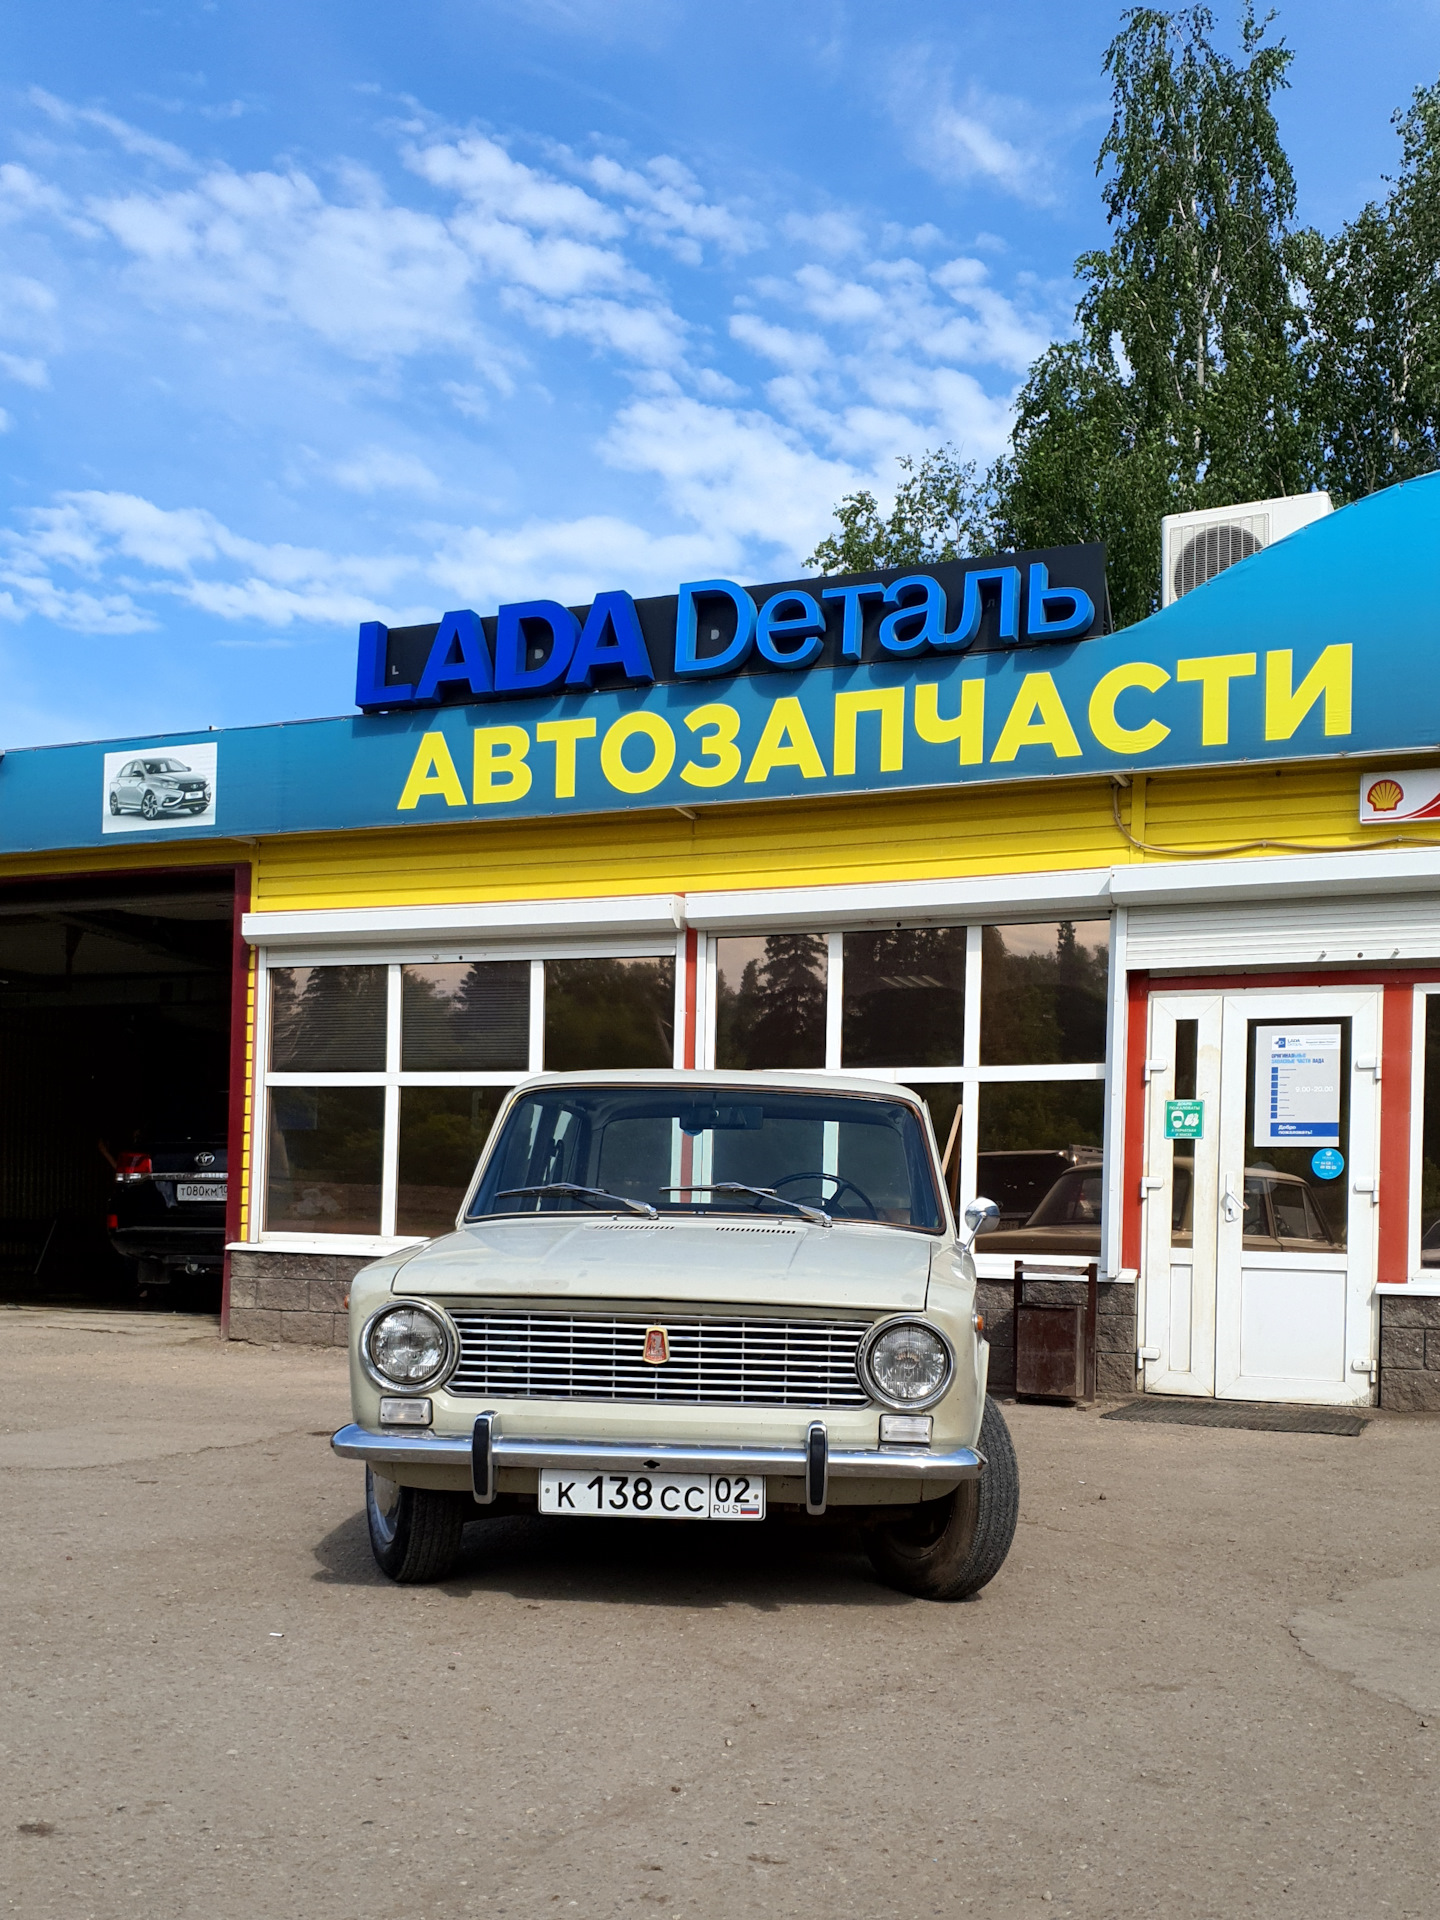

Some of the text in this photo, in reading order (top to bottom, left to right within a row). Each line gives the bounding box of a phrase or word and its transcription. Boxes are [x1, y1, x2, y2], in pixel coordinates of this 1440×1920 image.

[355, 590, 655, 707] LADA
[398, 643, 1353, 811] АВТОЗАПЧАСТИ
[713, 1504, 739, 1514] RUS
[715, 1477, 750, 1503] 02
